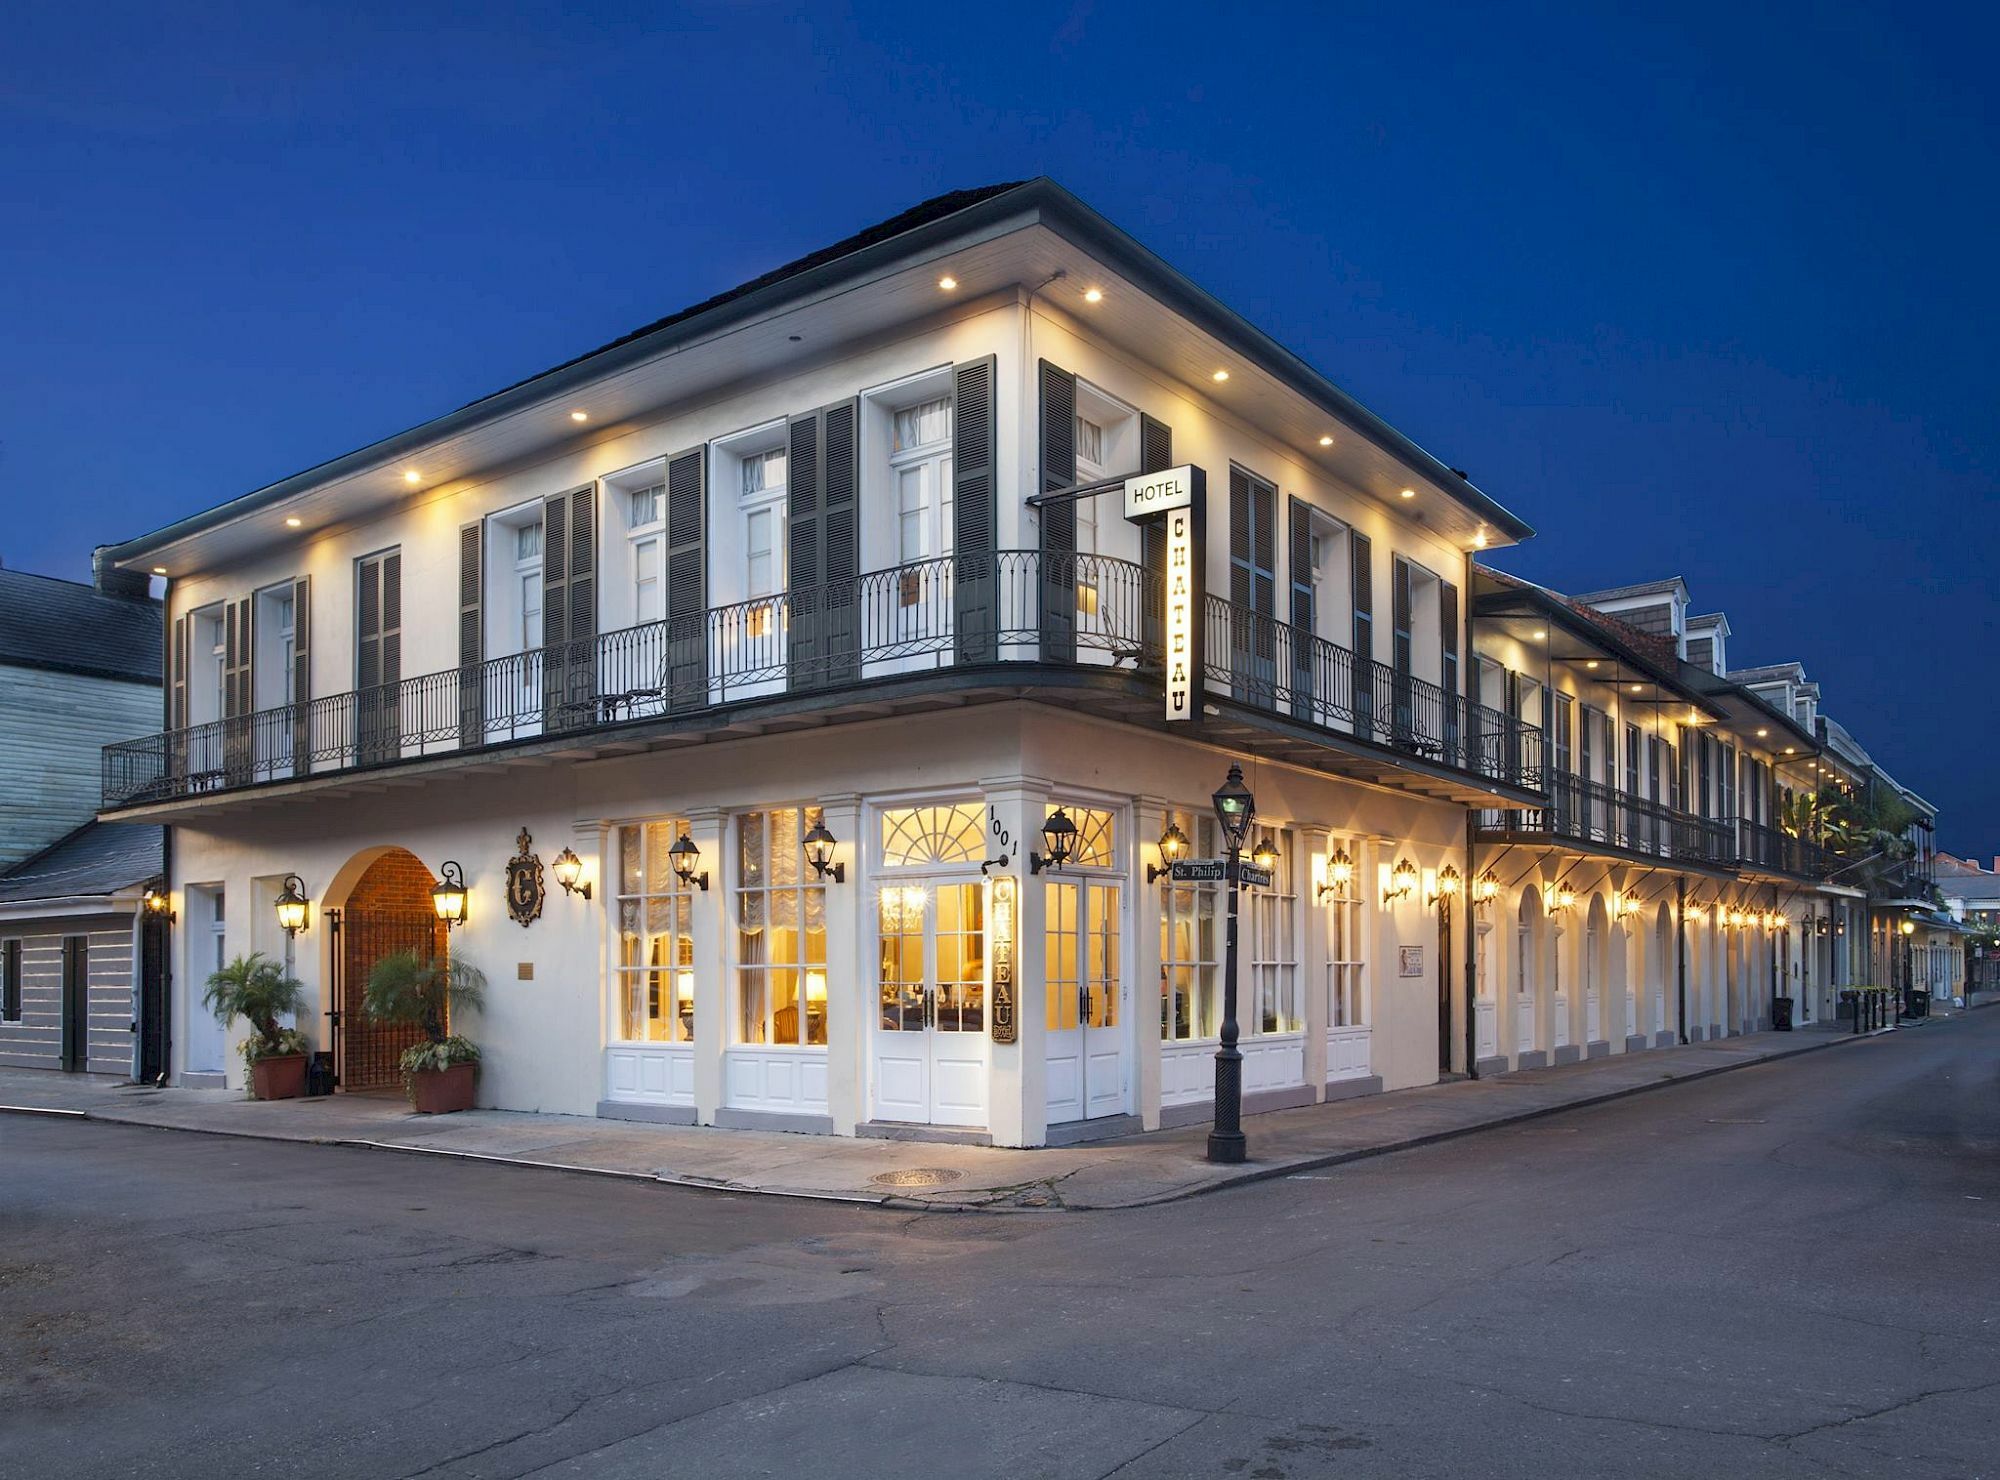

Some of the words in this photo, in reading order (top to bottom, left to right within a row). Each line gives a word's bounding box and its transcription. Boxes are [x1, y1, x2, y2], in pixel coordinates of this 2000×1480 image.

[1134, 479, 1183, 503] HOTEL
[1172, 517, 1186, 711] CHATEAU
[990, 805, 1018, 856] 1001
[1174, 866, 1187, 877] St.
[1191, 865, 1221, 880] Philip
